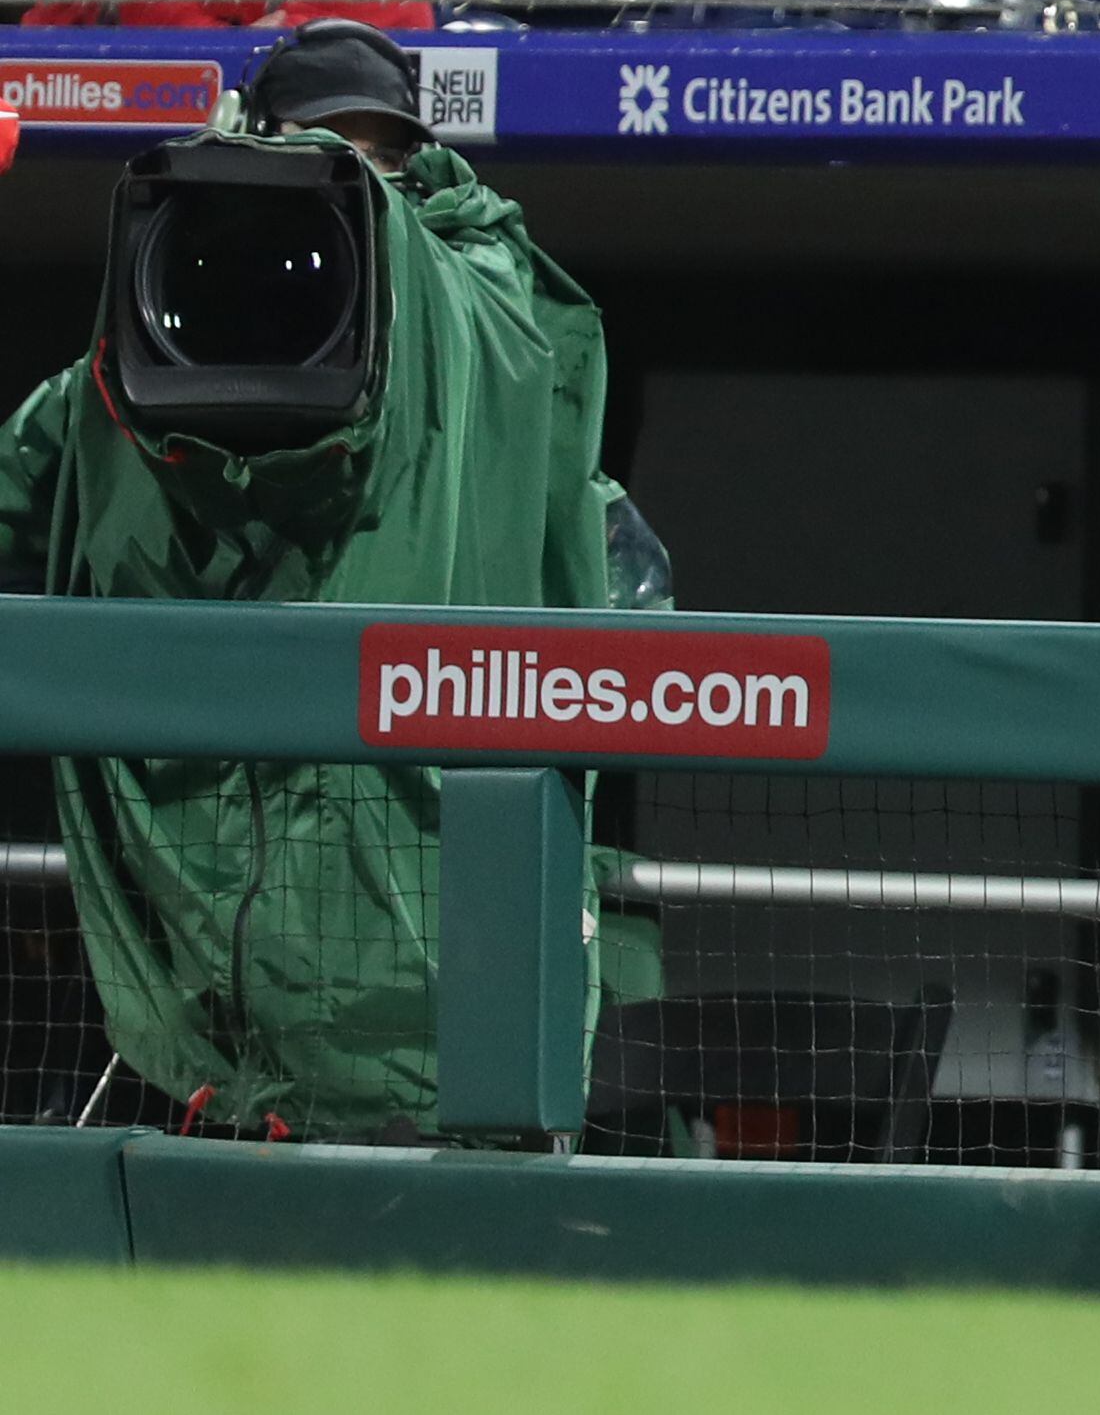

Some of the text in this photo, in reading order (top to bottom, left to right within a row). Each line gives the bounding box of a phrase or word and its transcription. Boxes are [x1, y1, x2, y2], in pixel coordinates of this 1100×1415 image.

[3, 72, 209, 111] phillies.com
[432, 70, 485, 96] NEW
[682, 76, 1025, 125] Citizens Bank Park
[377, 647, 809, 733] phillies.com
